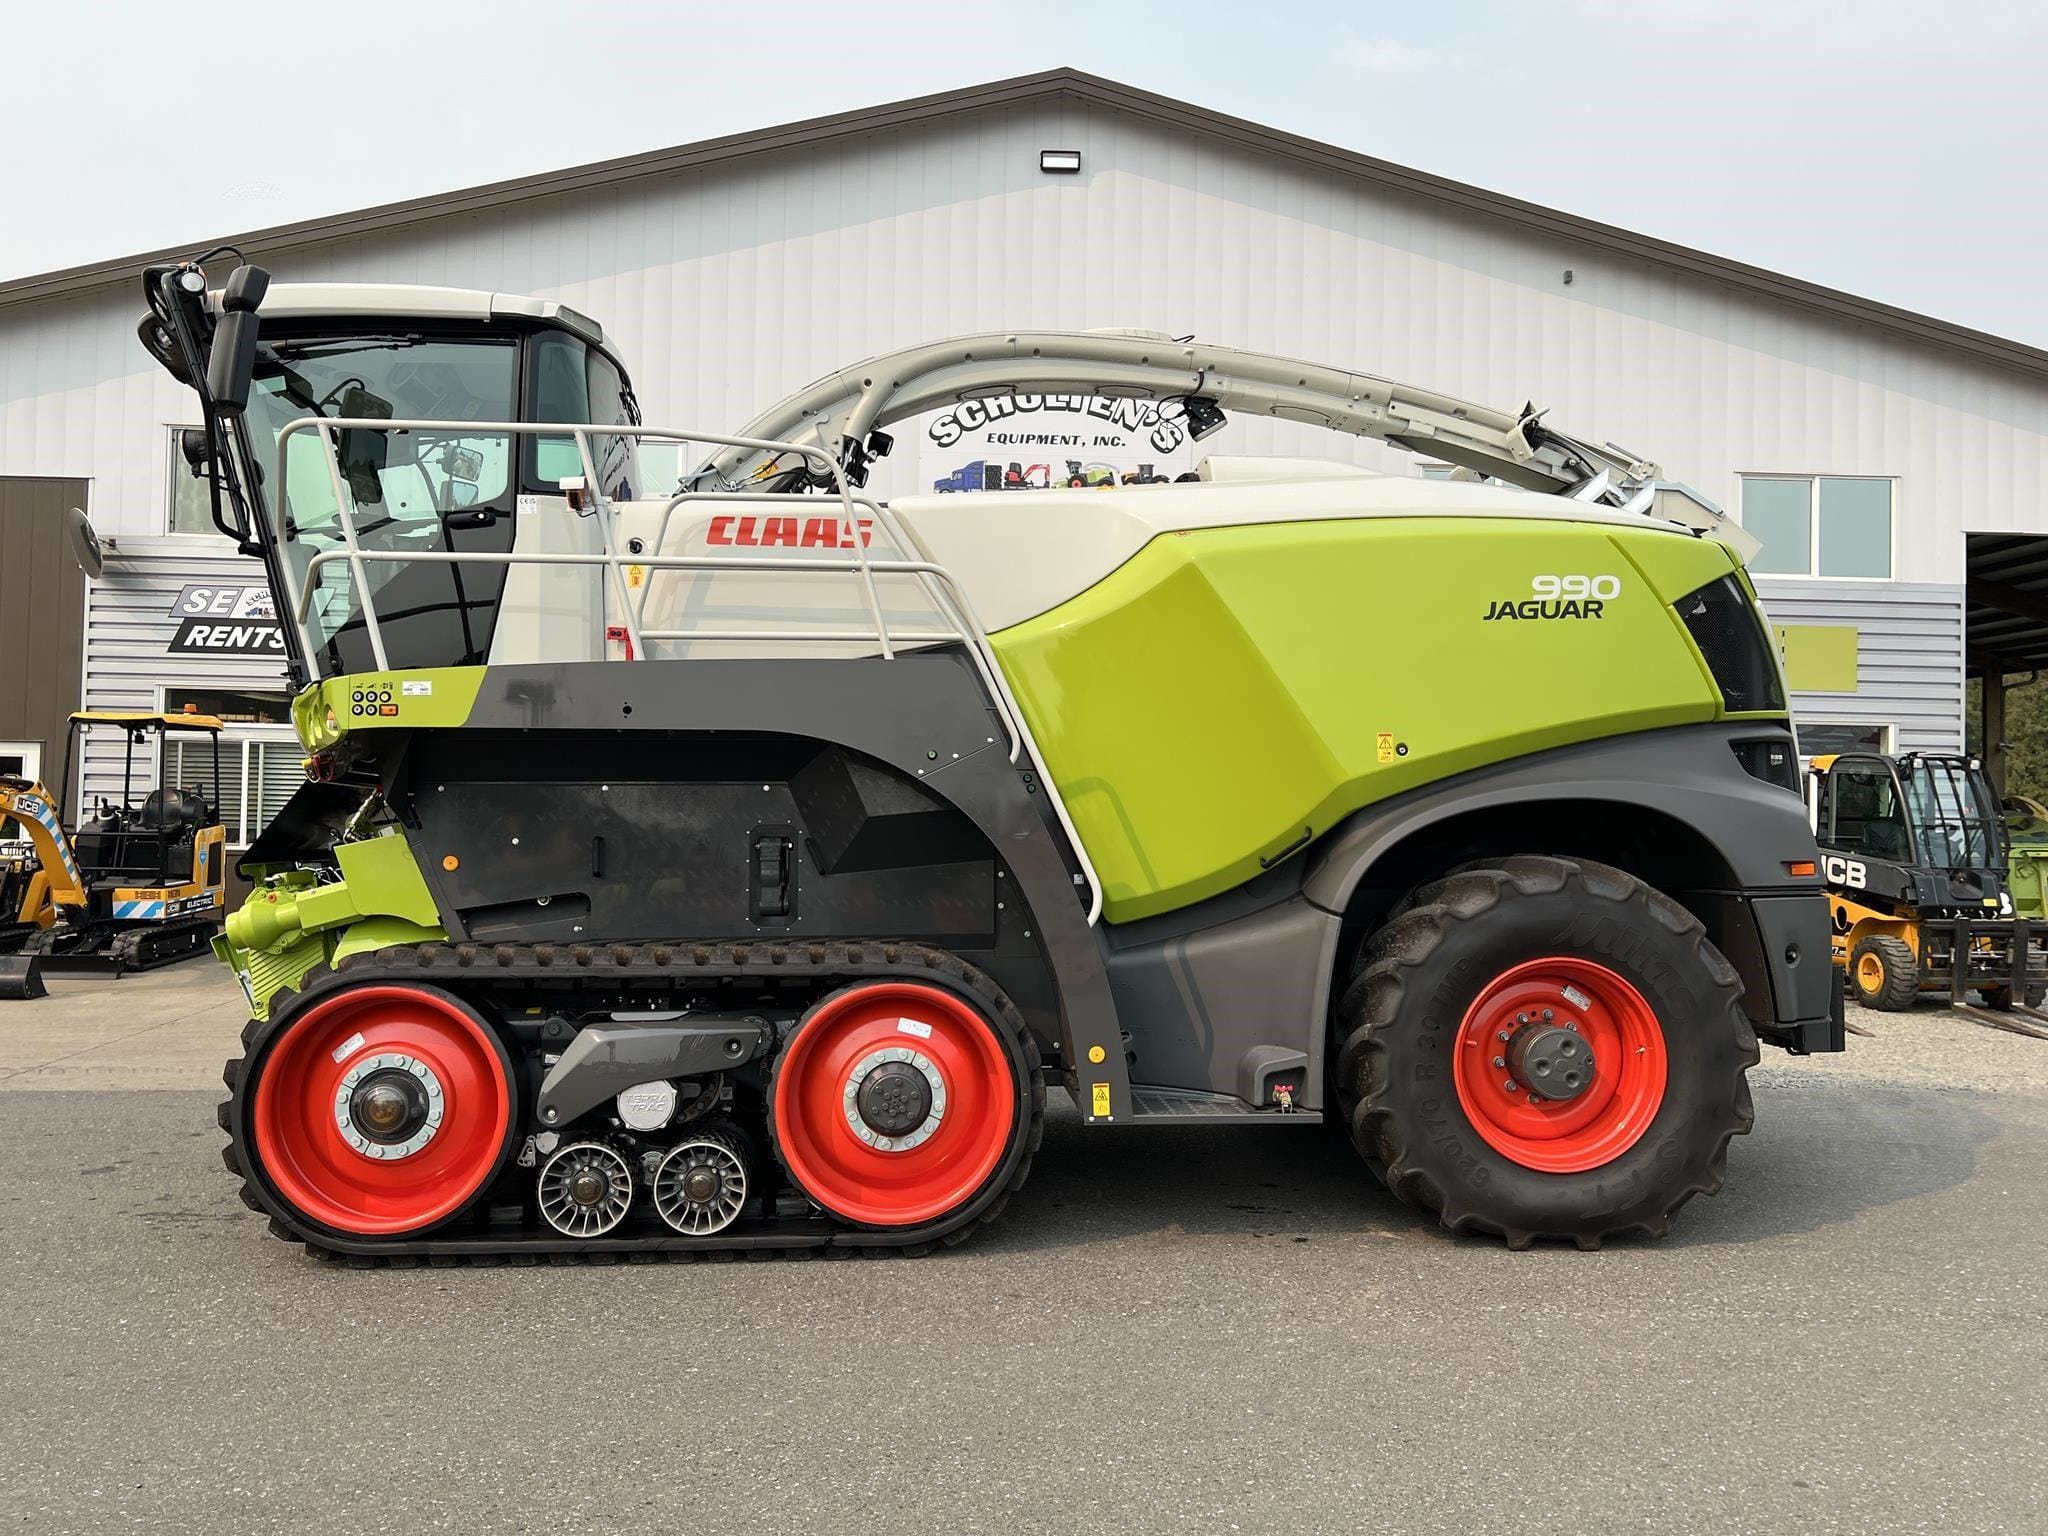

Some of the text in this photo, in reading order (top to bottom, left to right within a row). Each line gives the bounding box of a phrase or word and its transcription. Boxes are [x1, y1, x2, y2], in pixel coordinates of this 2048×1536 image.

[986, 433, 1126, 447] EQUIPMENT, INC.
[706, 516, 873, 548] CLAAS
[1532, 575, 1621, 601] 990
[1483, 600, 1604, 620] JAGUAR
[183, 625, 286, 648] RENTS
[18, 799, 39, 813] JCB
[187, 897, 212, 908] ELECTRIC
[626, 1093, 667, 1103] TERRA
[630, 1103, 665, 1112] TRAC
